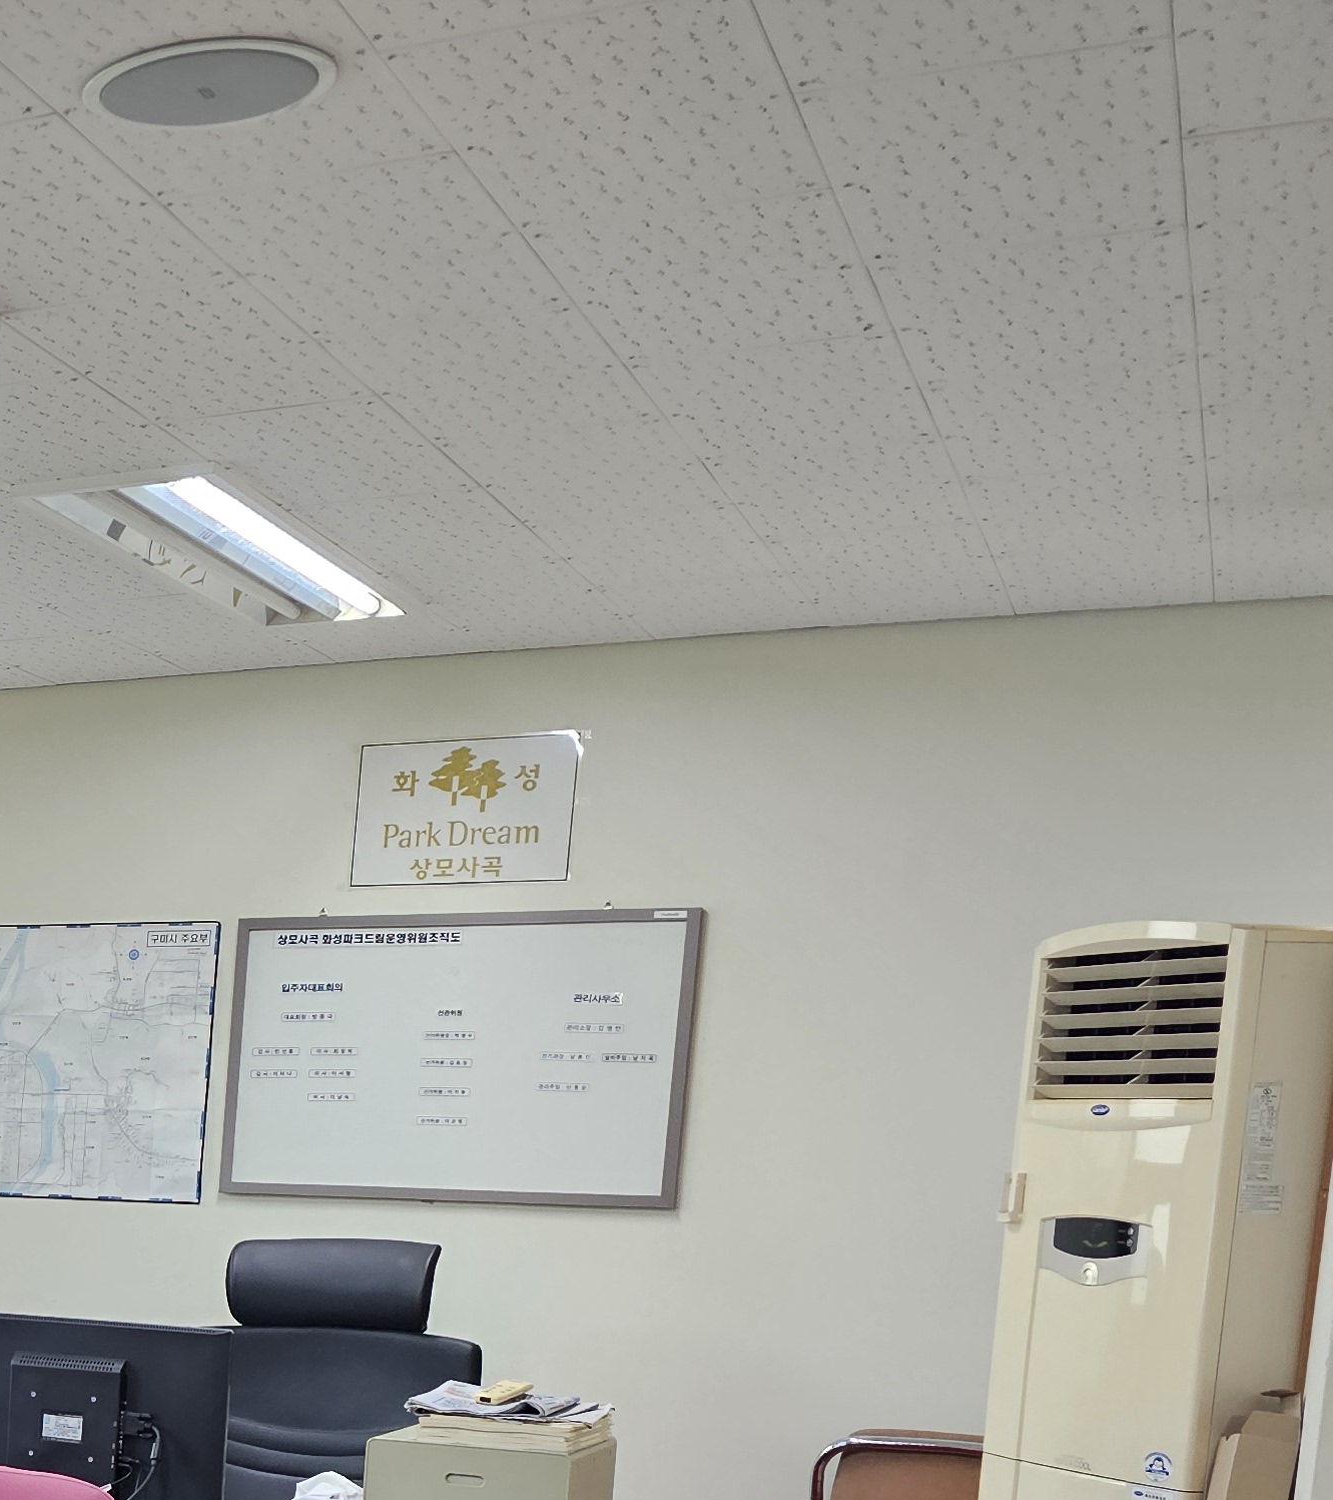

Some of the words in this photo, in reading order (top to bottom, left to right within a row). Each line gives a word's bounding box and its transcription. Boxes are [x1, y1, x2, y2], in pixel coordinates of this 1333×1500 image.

[383, 821, 441, 849] Park
[448, 820, 540, 847] Dream
[410, 856, 503, 880] 상모사곡
[151, 934, 178, 944] 구미시
[181, 933, 208, 943] 주요부
[277, 934, 319, 945] 상모사곡
[281, 982, 344, 993] 입주자대표회의
